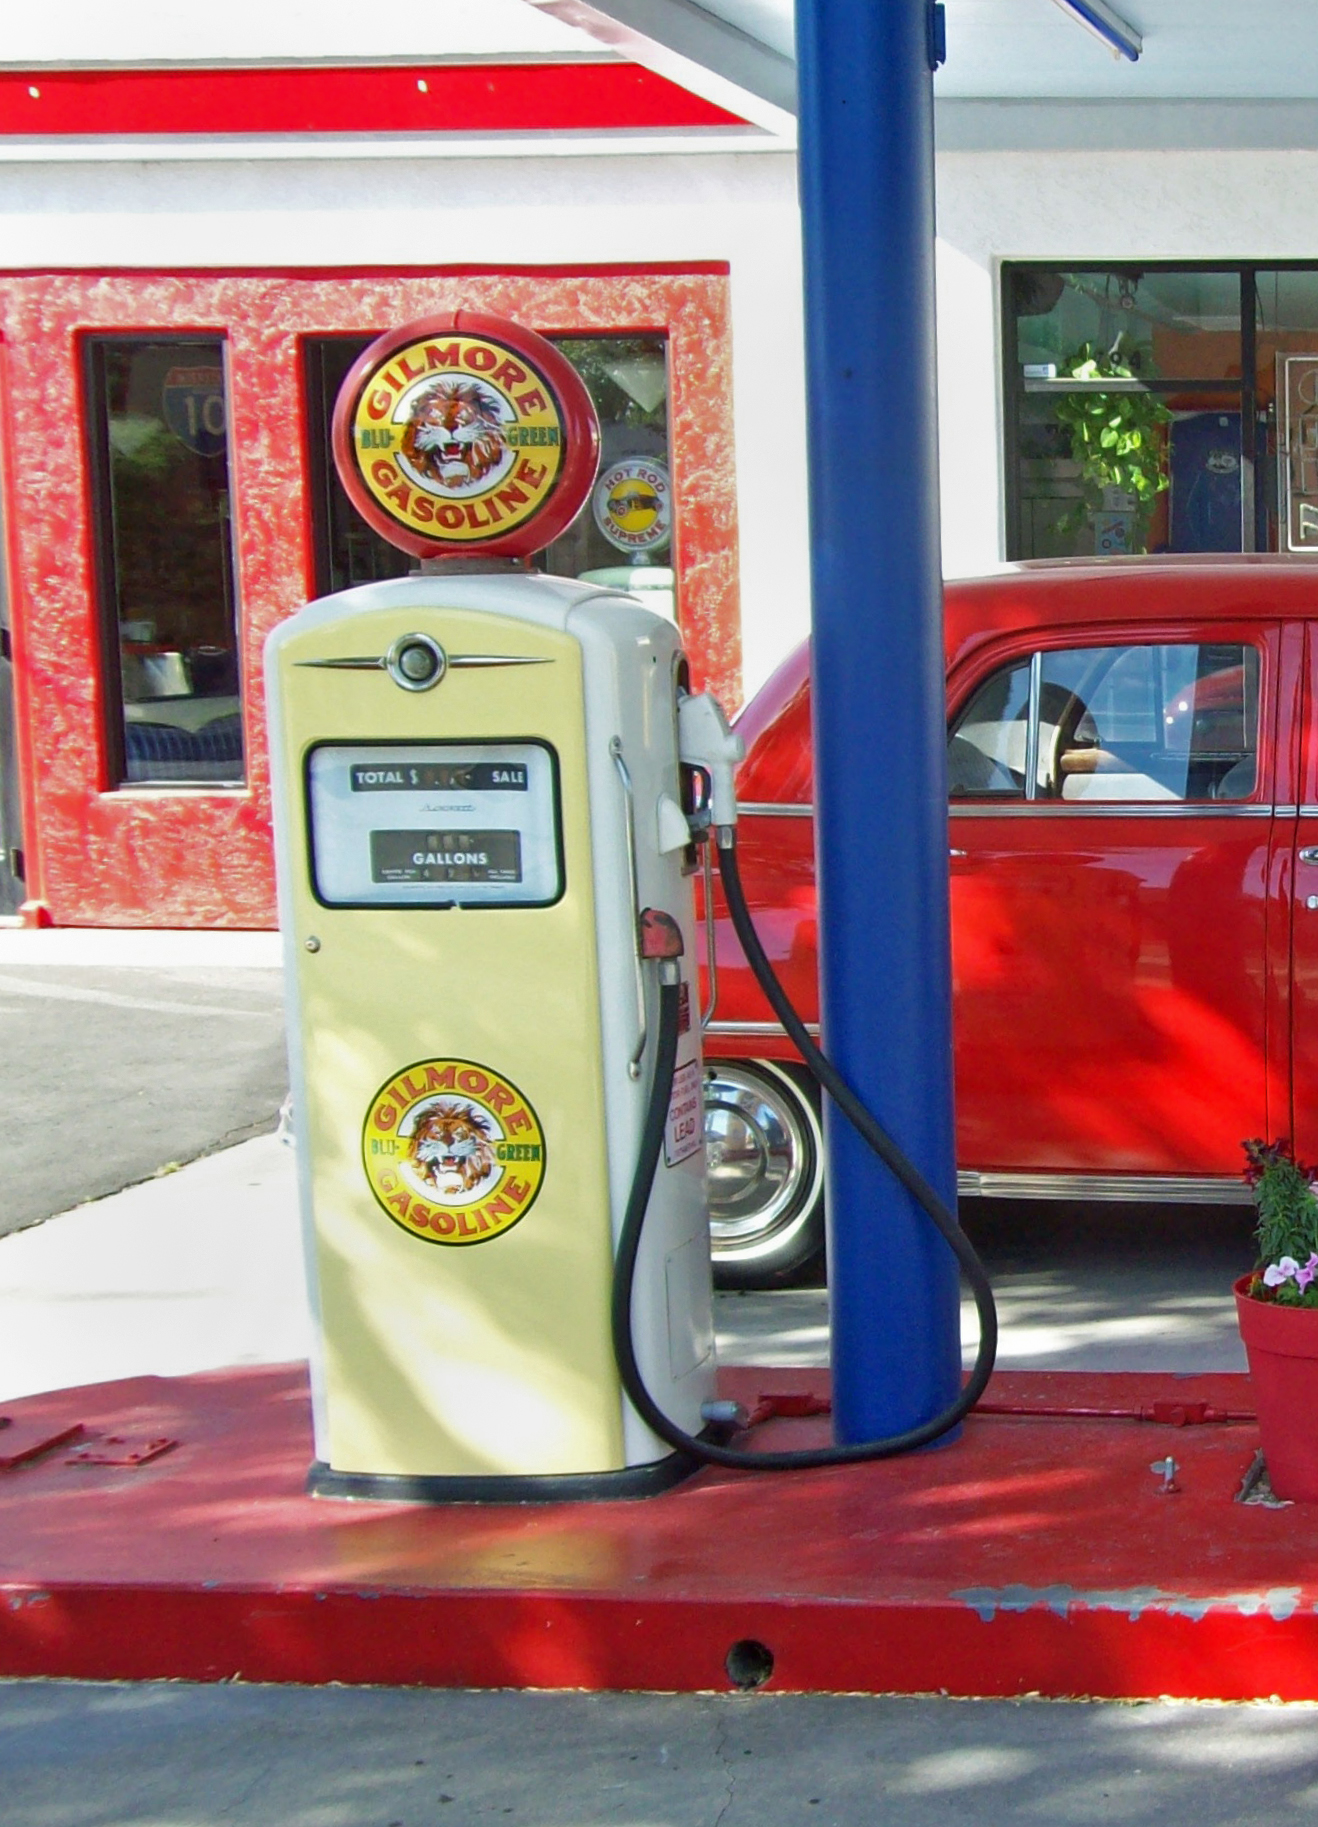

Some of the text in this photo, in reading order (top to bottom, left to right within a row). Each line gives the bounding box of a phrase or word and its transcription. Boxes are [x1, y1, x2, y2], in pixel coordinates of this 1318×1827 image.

[367, 342, 547, 420] GILMORE
[185, 394, 224, 437] 10
[506, 426, 560, 447] GREEN
[605, 468, 666, 492] HOT ROD
[370, 458, 548, 530] GASOLINE
[603, 516, 667, 543] SUPREME
[356, 771, 404, 785] TOTAL
[491, 770, 524, 784] SALE
[412, 852, 488, 866] GALLONS
[374, 1065, 533, 1136] GILMORE
[496, 1144, 541, 1162] GREEN
[377, 1168, 532, 1236] GASOLINE
